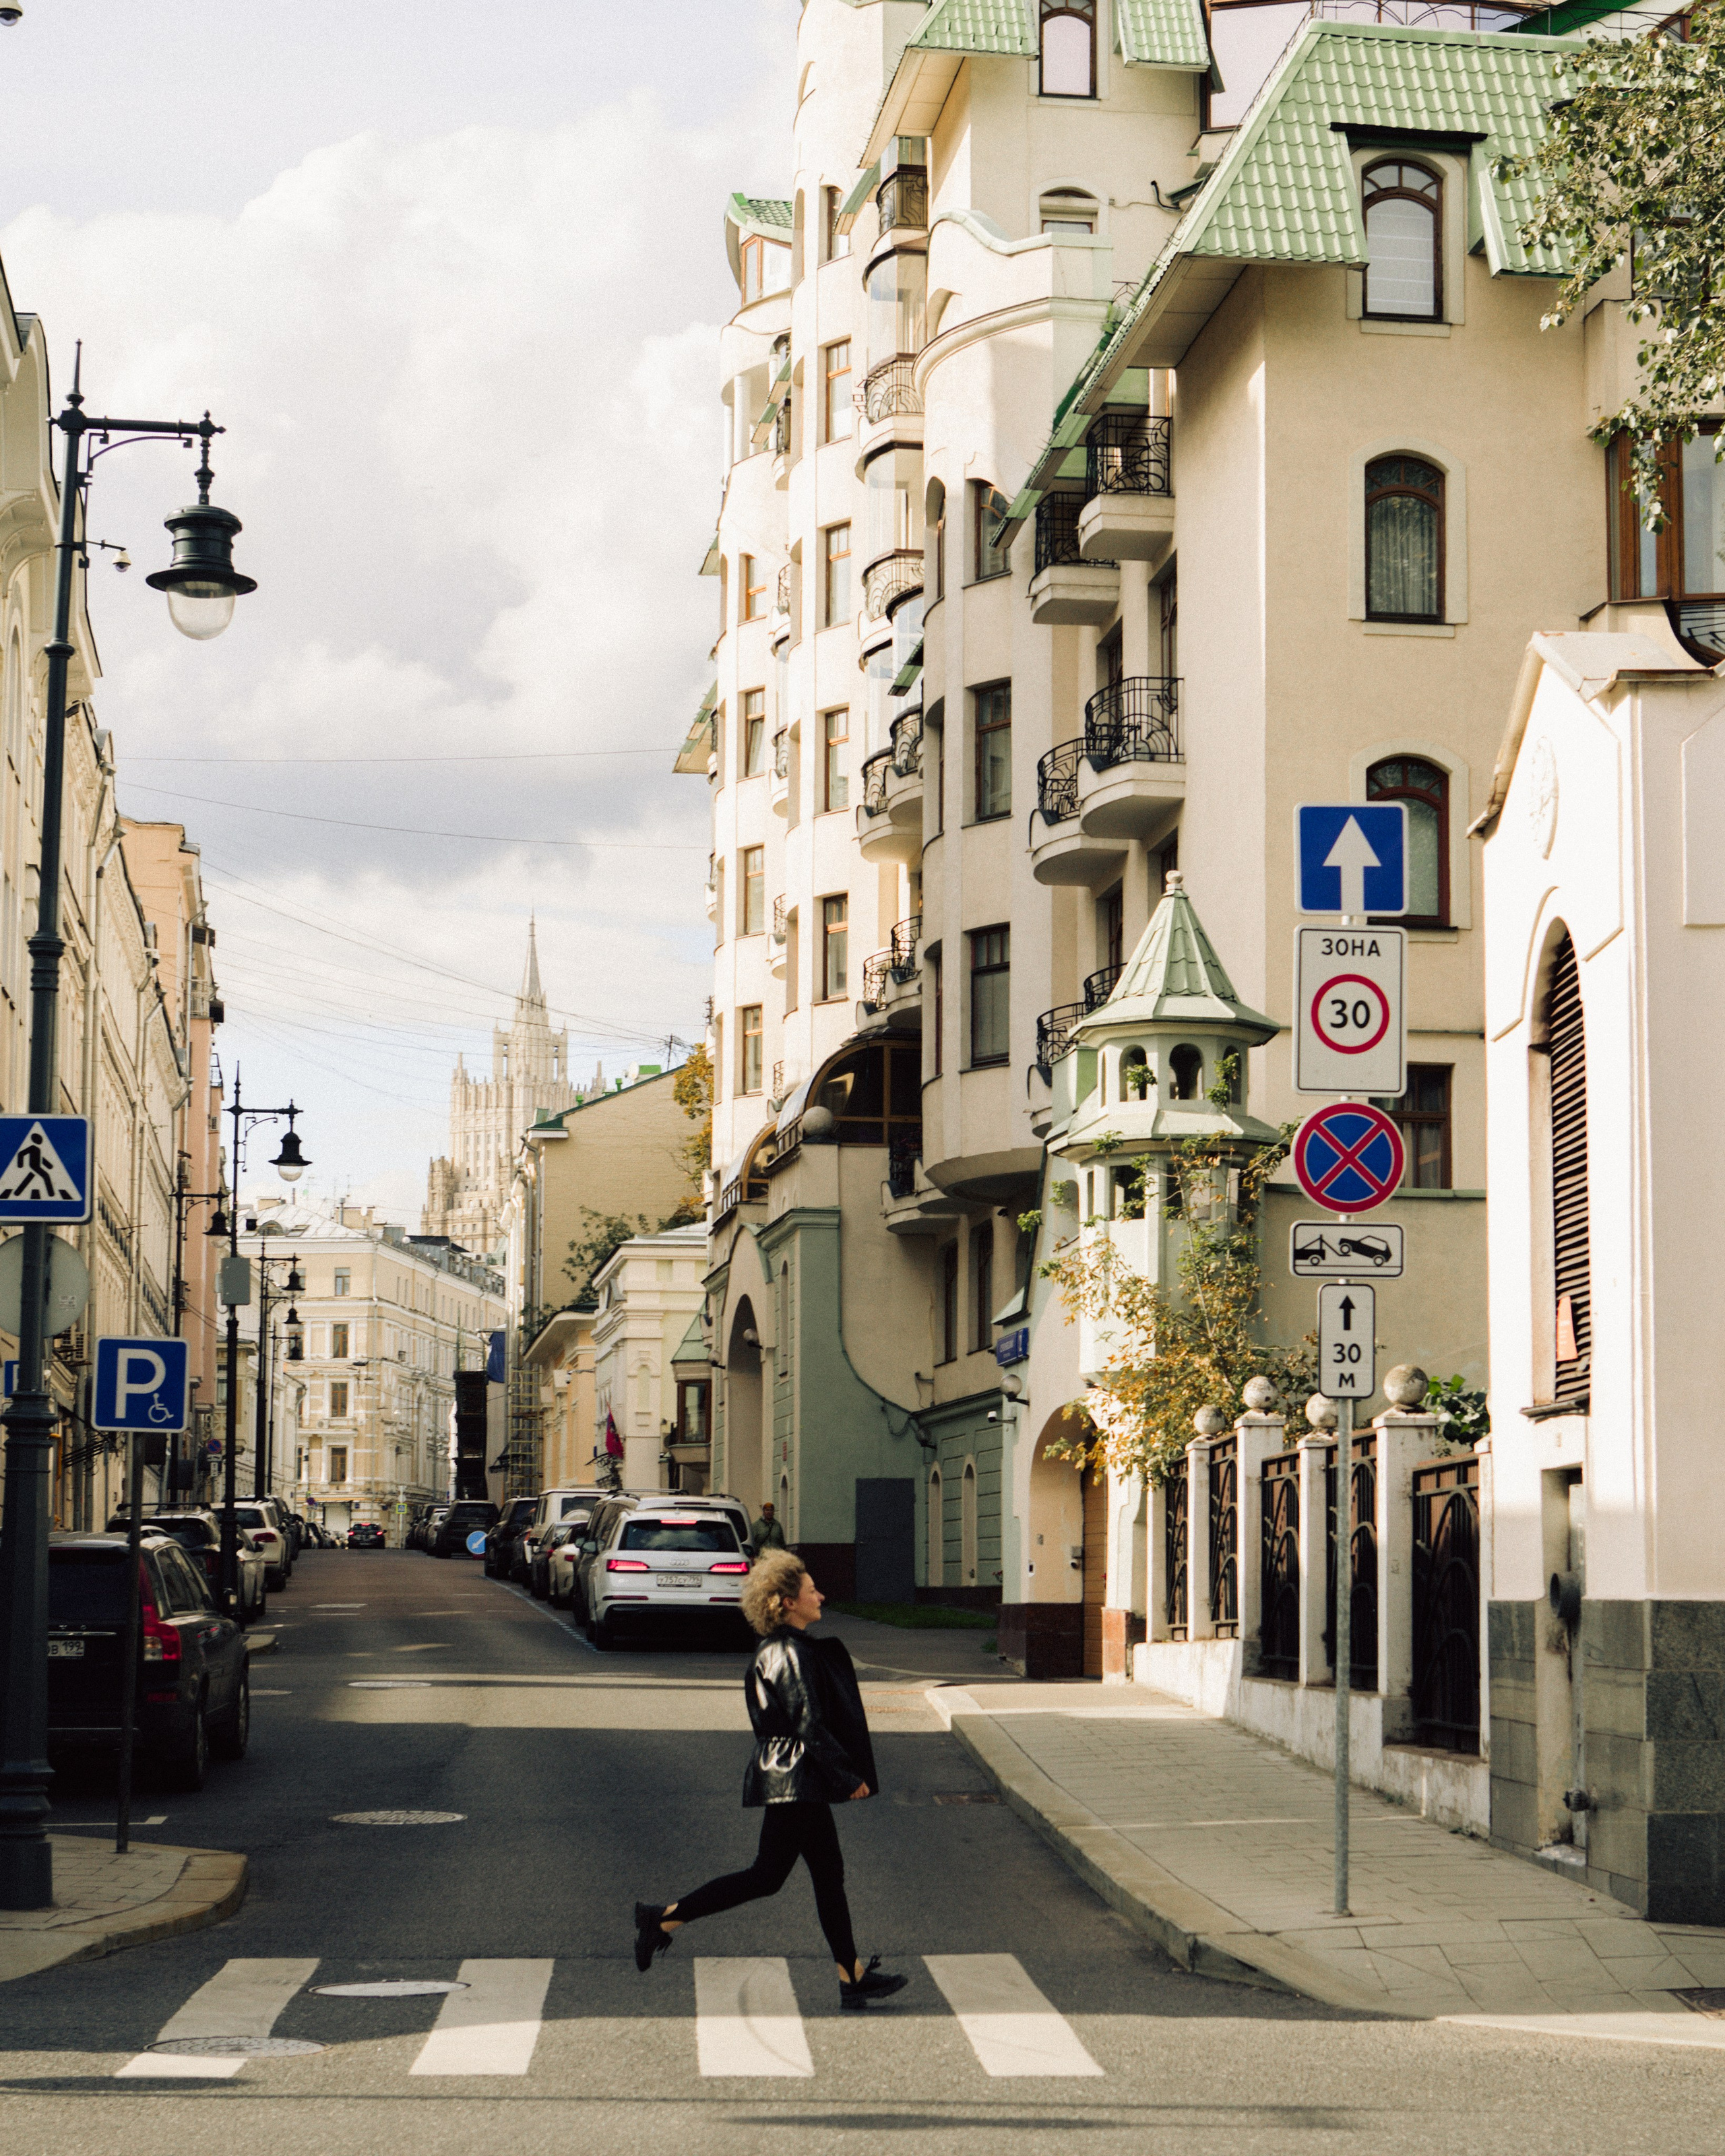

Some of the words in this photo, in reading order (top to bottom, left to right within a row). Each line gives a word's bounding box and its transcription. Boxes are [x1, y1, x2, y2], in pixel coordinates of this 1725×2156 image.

[1321, 938, 1381, 957] ЗОНА
[1330, 999, 1371, 1029] 30
[1333, 1343, 1361, 1364] 30
[115, 1348, 166, 1419] P
